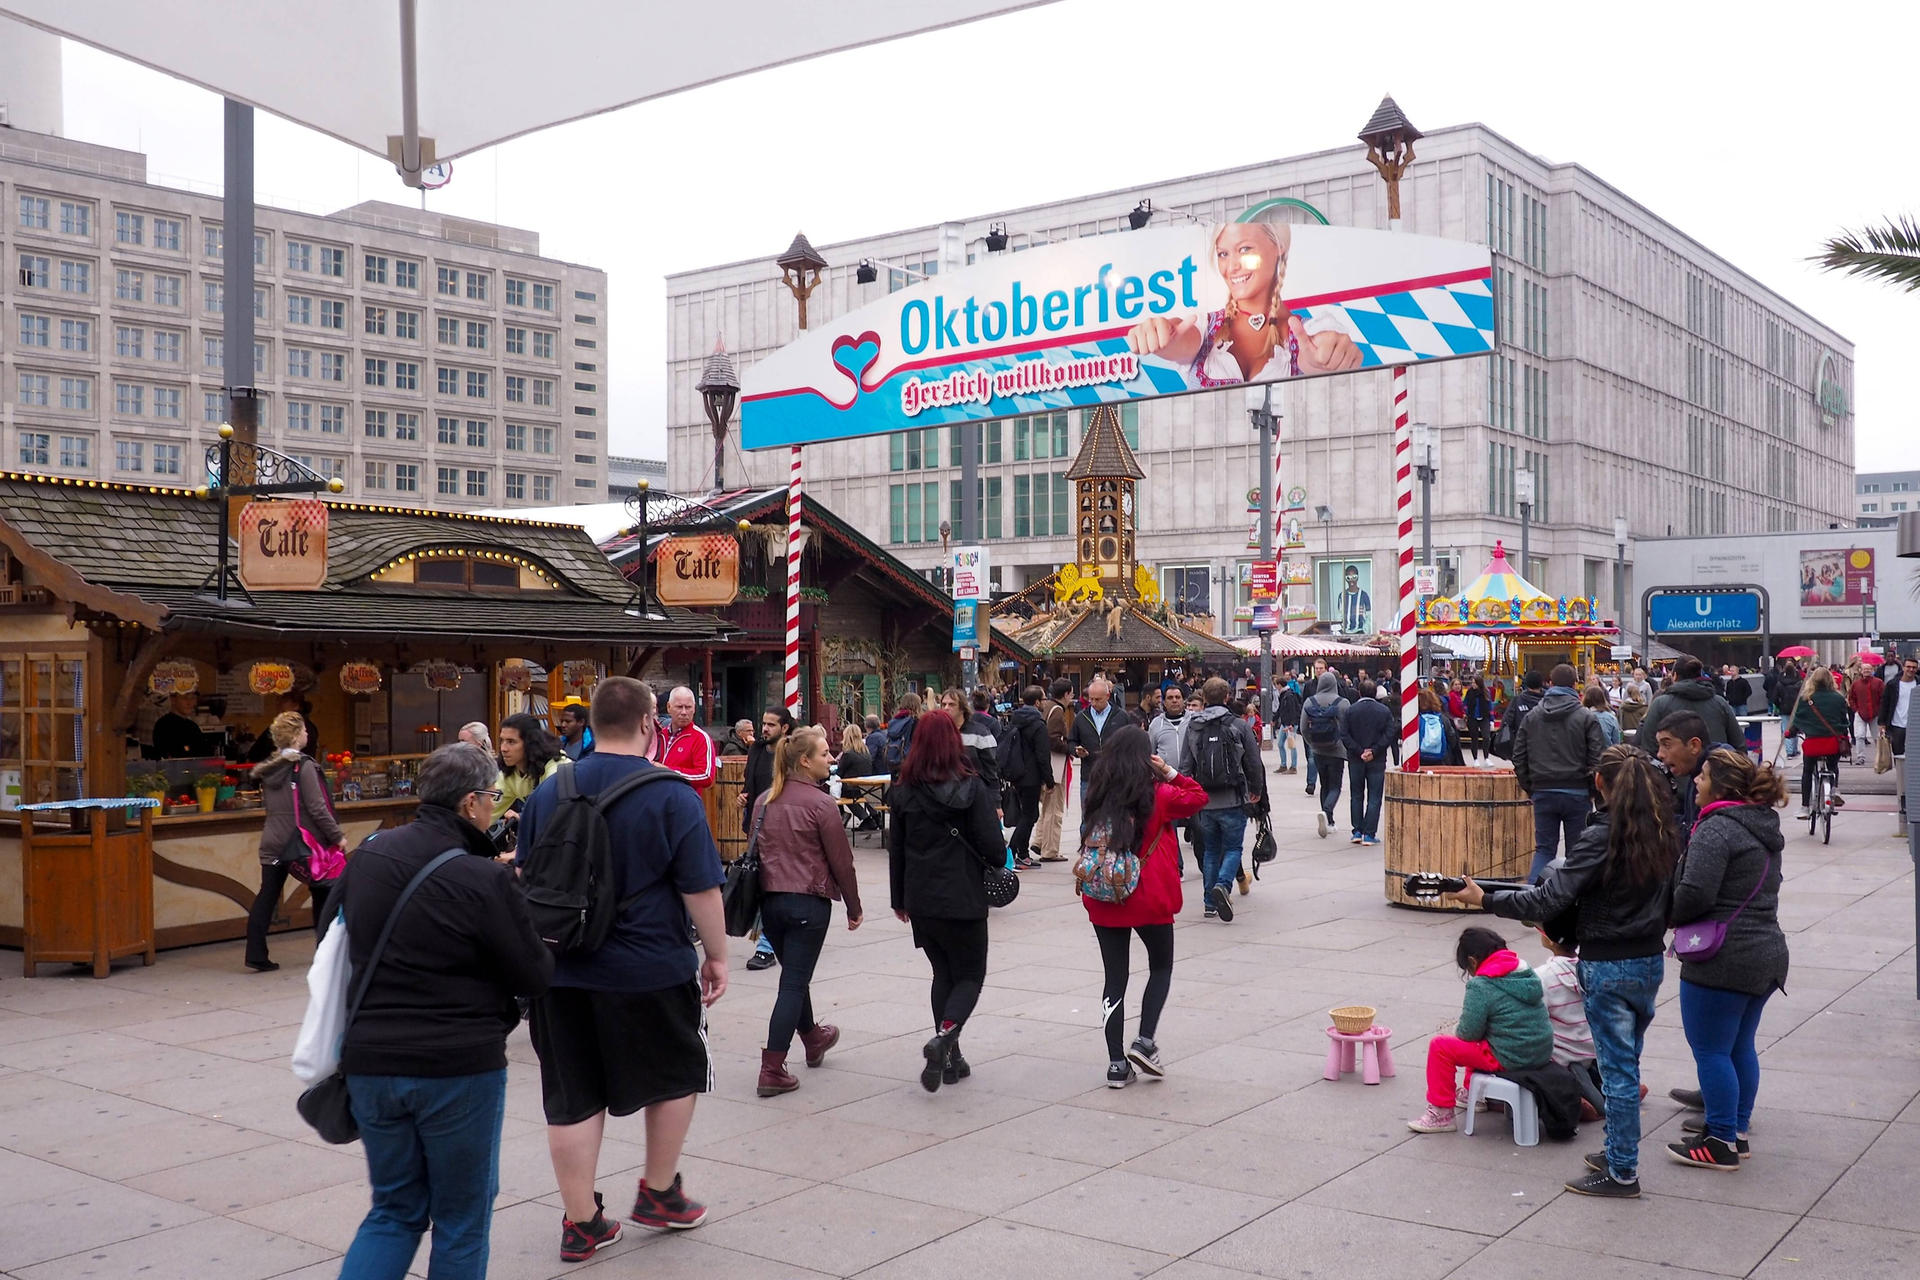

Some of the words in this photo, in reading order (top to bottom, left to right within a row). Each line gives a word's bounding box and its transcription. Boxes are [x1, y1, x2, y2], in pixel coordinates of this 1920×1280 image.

[899, 254, 1198, 355] Oktoberfest
[903, 367, 989, 411] Herzlich
[996, 355, 1133, 391] willkommen
[257, 517, 309, 557] Café
[673, 548, 720, 580] Café
[1666, 618, 1742, 631] Alexanderplatz
[1695, 597, 1712, 616] U
